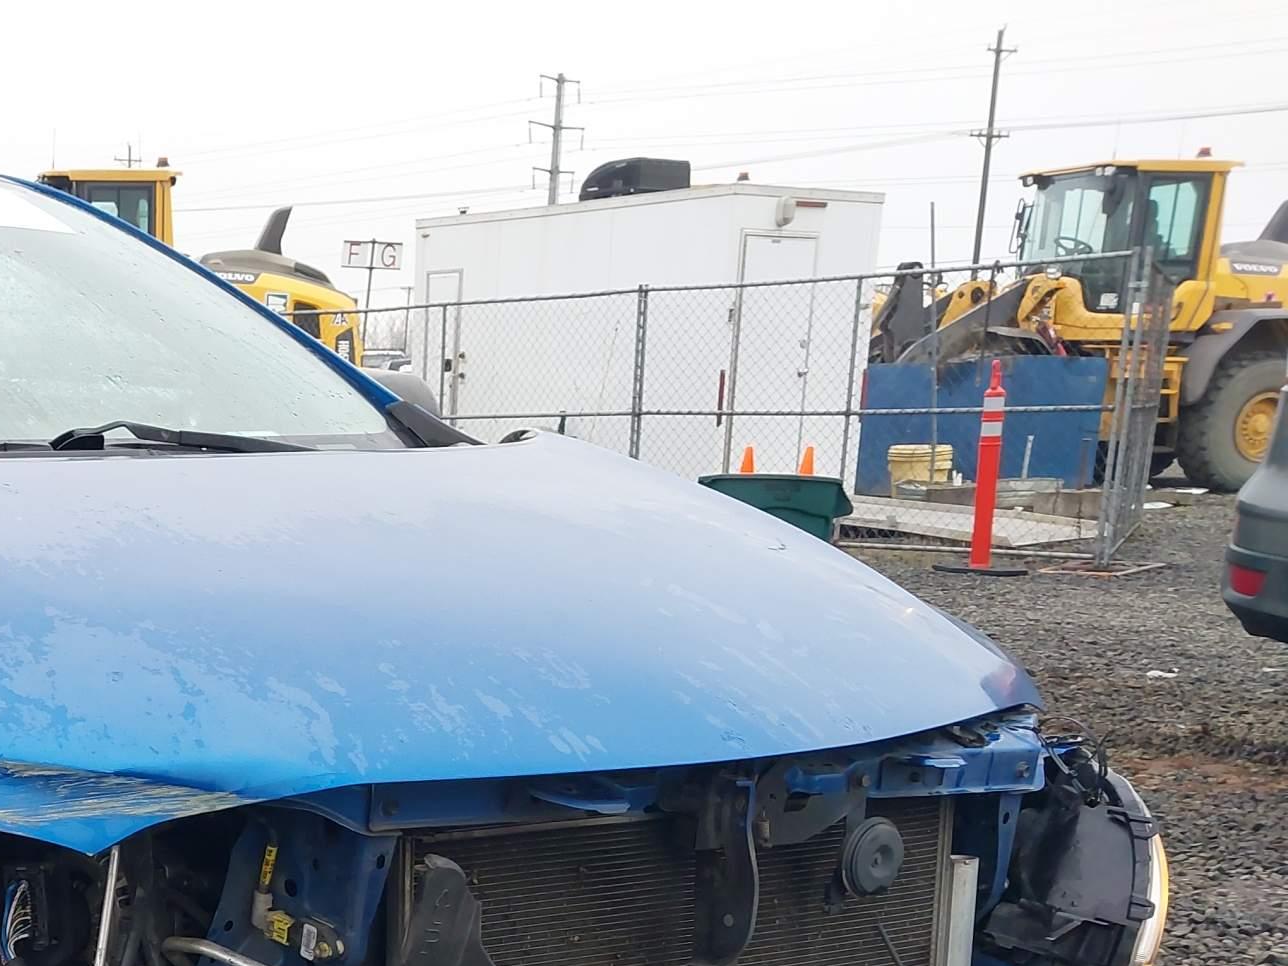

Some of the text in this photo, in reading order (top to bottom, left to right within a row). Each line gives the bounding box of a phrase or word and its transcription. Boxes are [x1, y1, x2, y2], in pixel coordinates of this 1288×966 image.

[347, 241, 361, 264] F
[381, 243, 396, 267] G
[1232, 263, 1278, 272] VOLVO
[215, 271, 255, 282] OLVO
